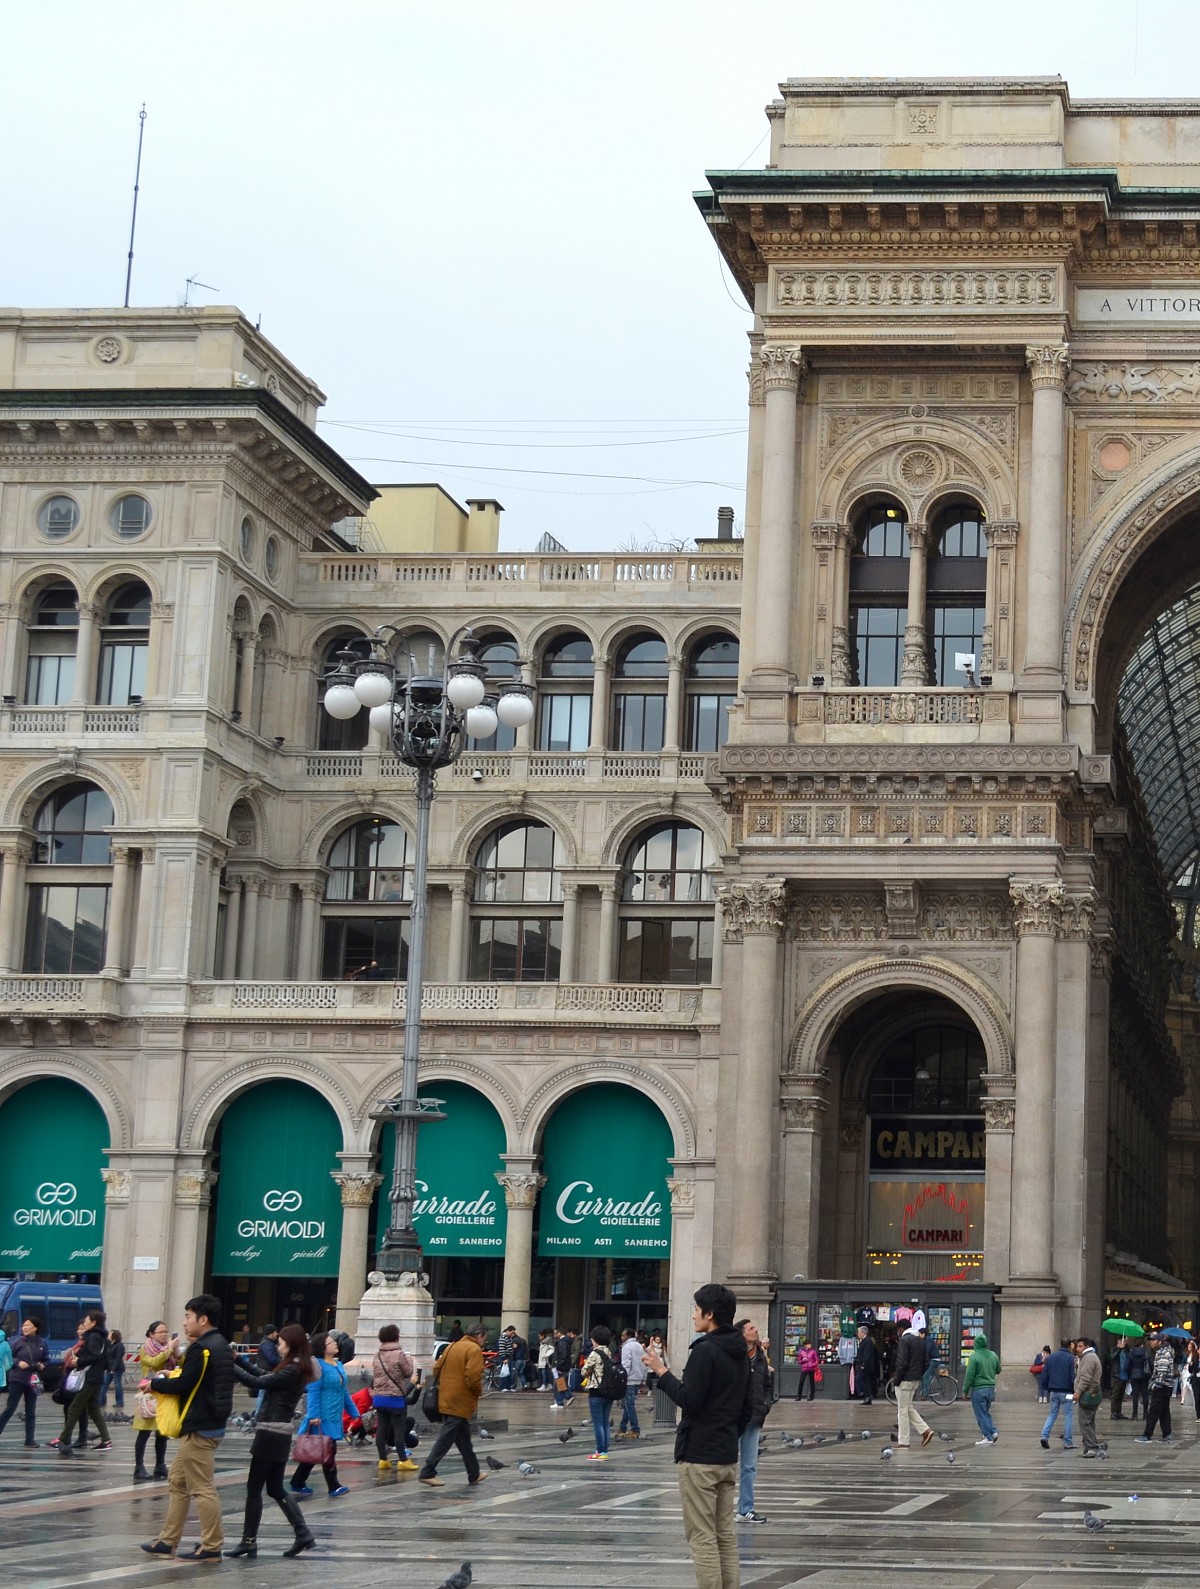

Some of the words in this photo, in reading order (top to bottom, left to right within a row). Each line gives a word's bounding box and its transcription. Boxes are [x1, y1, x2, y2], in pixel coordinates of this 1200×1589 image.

[1100, 297, 1112, 312] A
[876, 1130, 985, 1159] CAMPAR
[556, 1180, 663, 1224] Currado
[14, 1208, 97, 1227] GRIMOLDI
[435, 1215, 496, 1225] GIOIELLERIE
[600, 1216, 661, 1226] GIOIELLERIE
[237, 1220, 325, 1239] GRIMOLDI
[908, 1229, 963, 1243] CAMPARI
[429, 1237, 448, 1245] ASTI
[459, 1238, 503, 1246] SANREMO
[546, 1236, 582, 1246] MILANO
[594, 1237, 612, 1246] ASTI
[624, 1238, 668, 1247] SANREMO
[230, 1245, 262, 1261] orologi
[289, 1245, 329, 1262] gioielli
